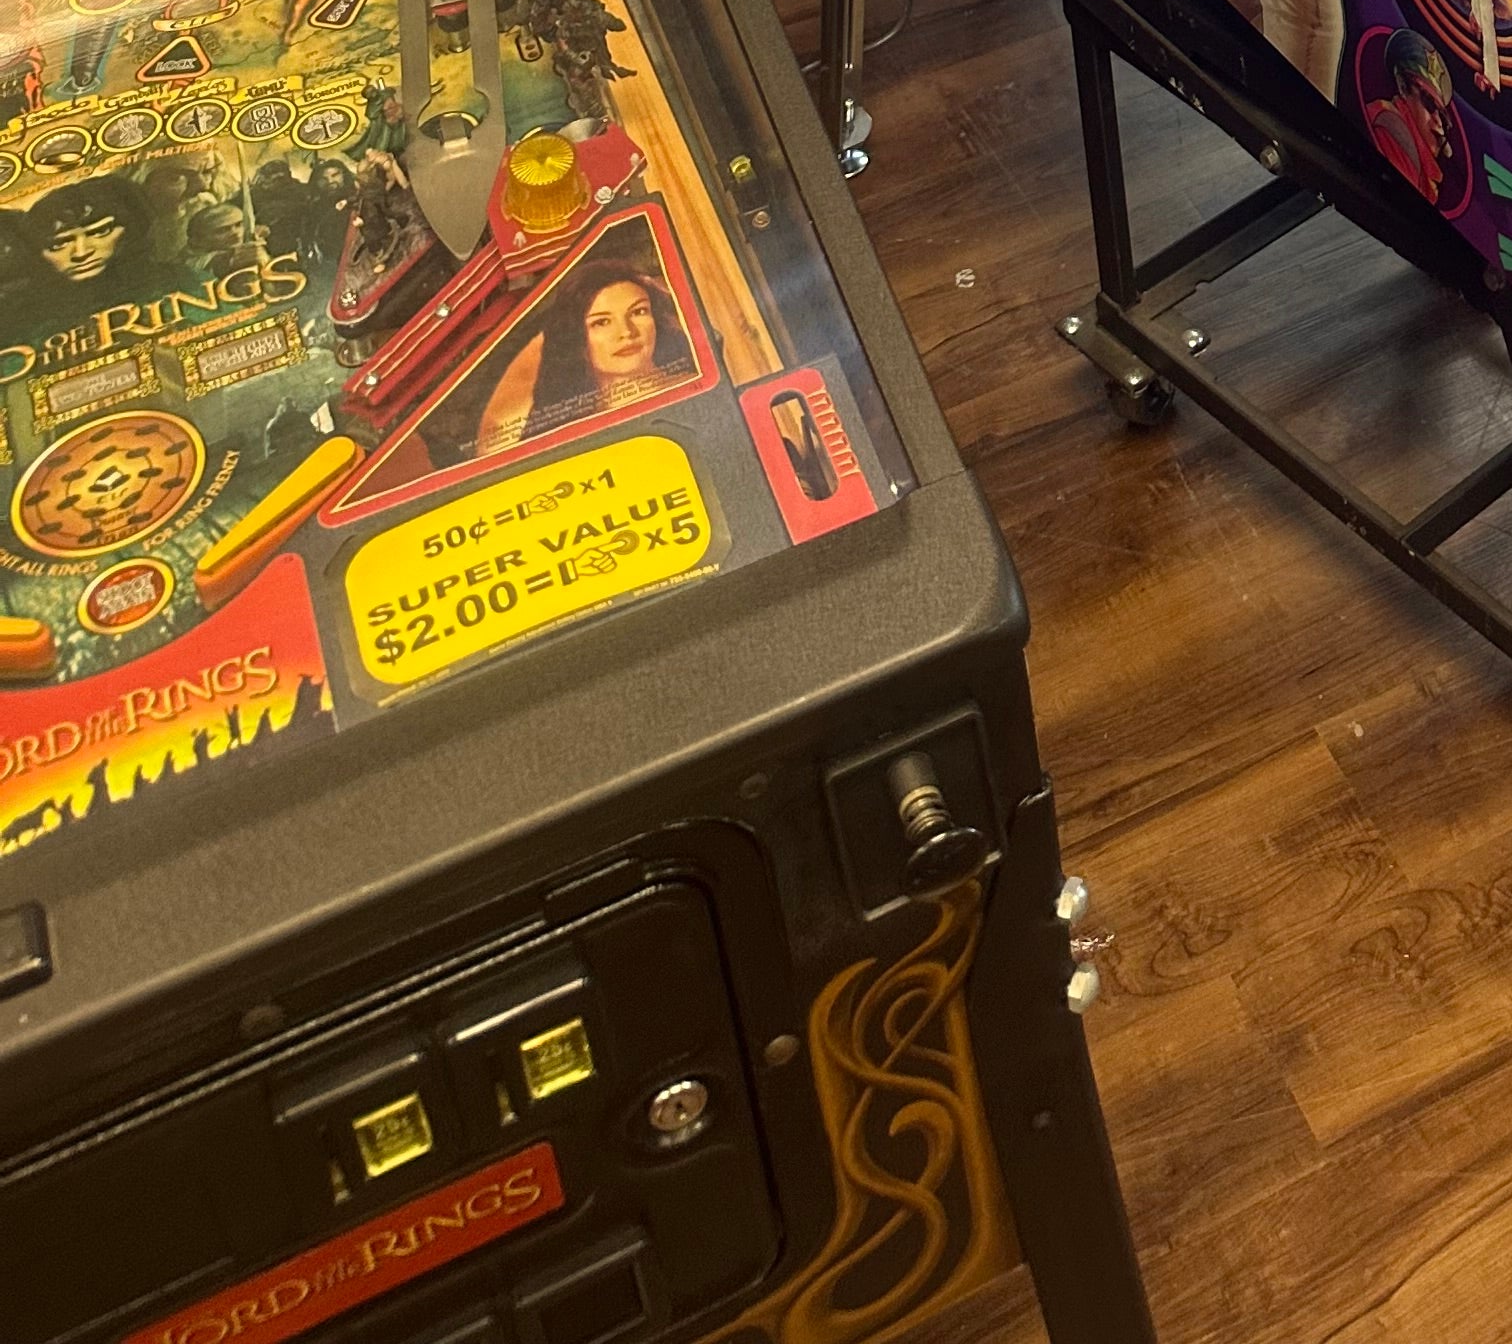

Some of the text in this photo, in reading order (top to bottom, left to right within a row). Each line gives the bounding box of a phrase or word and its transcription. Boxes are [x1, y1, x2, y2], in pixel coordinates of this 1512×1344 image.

[155, 57, 198, 73] LOCK
[90, 252, 308, 351] RINGS
[41, 335, 97, 365] THE
[45, 325, 86, 349] OF
[23, 449, 241, 577] ALL RINGS FOR RING FRENZY
[580, 468, 616, 495] x1
[368, 486, 692, 627] SUPER VALUE
[644, 511, 701, 552] x5
[122, 646, 279, 736] RINGS
[357, 1167, 543, 1274] RINGS
